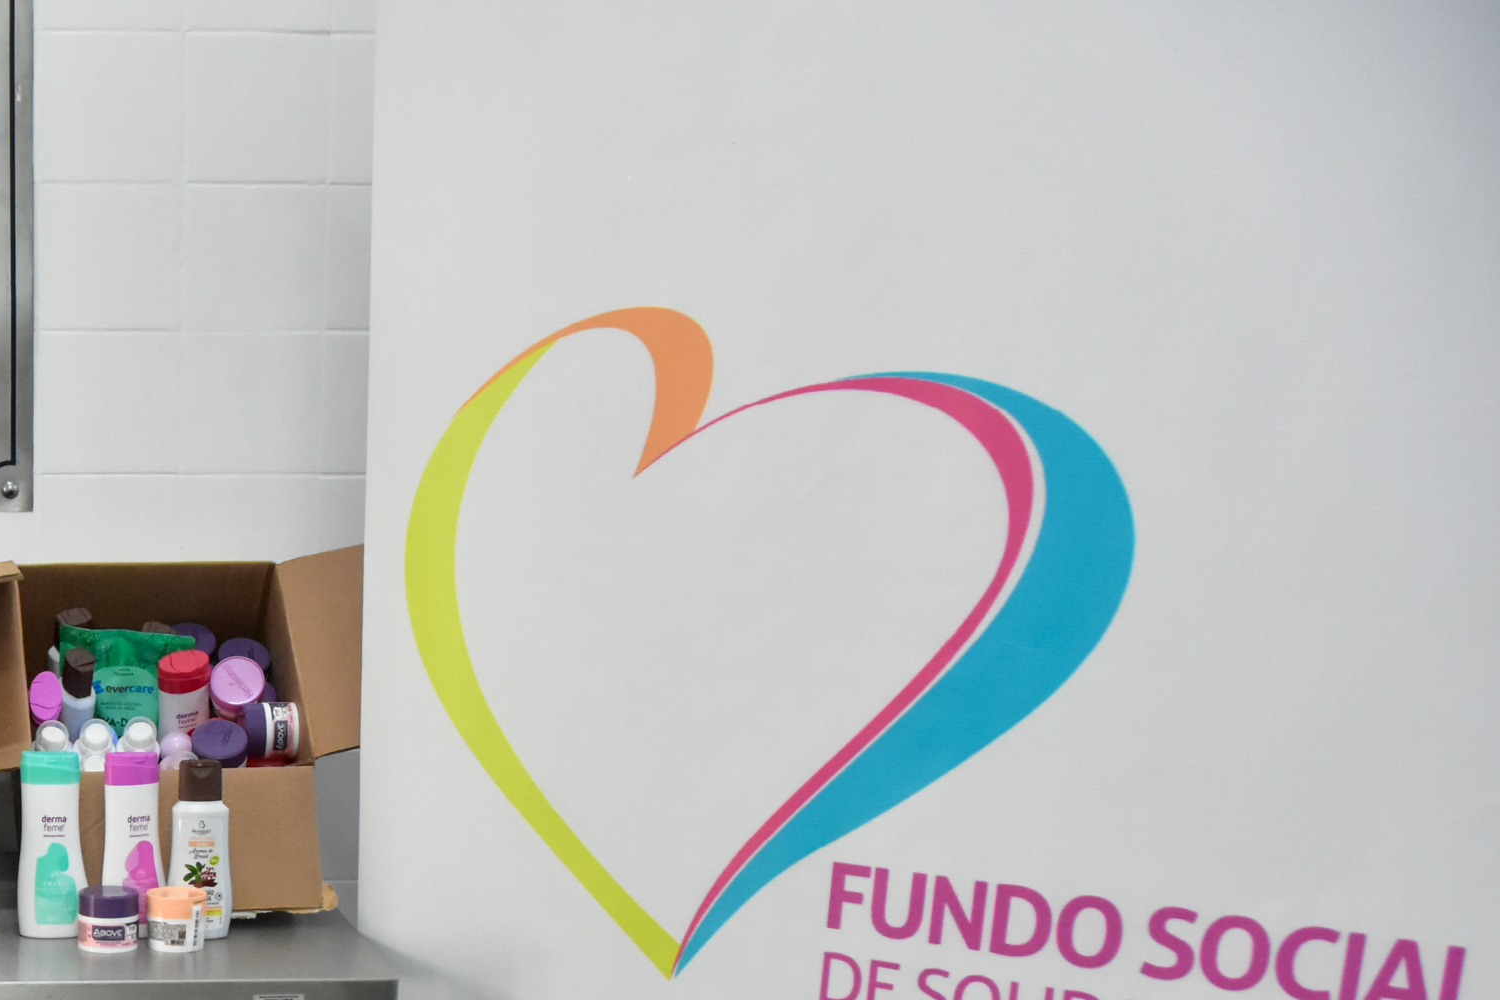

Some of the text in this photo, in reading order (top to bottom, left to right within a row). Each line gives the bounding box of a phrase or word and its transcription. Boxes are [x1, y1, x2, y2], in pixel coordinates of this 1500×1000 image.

[106, 685, 154, 694] evercare
[42, 815, 67, 823] derma
[128, 815, 150, 823] derma
[826, 861, 1123, 969] FUNDO
